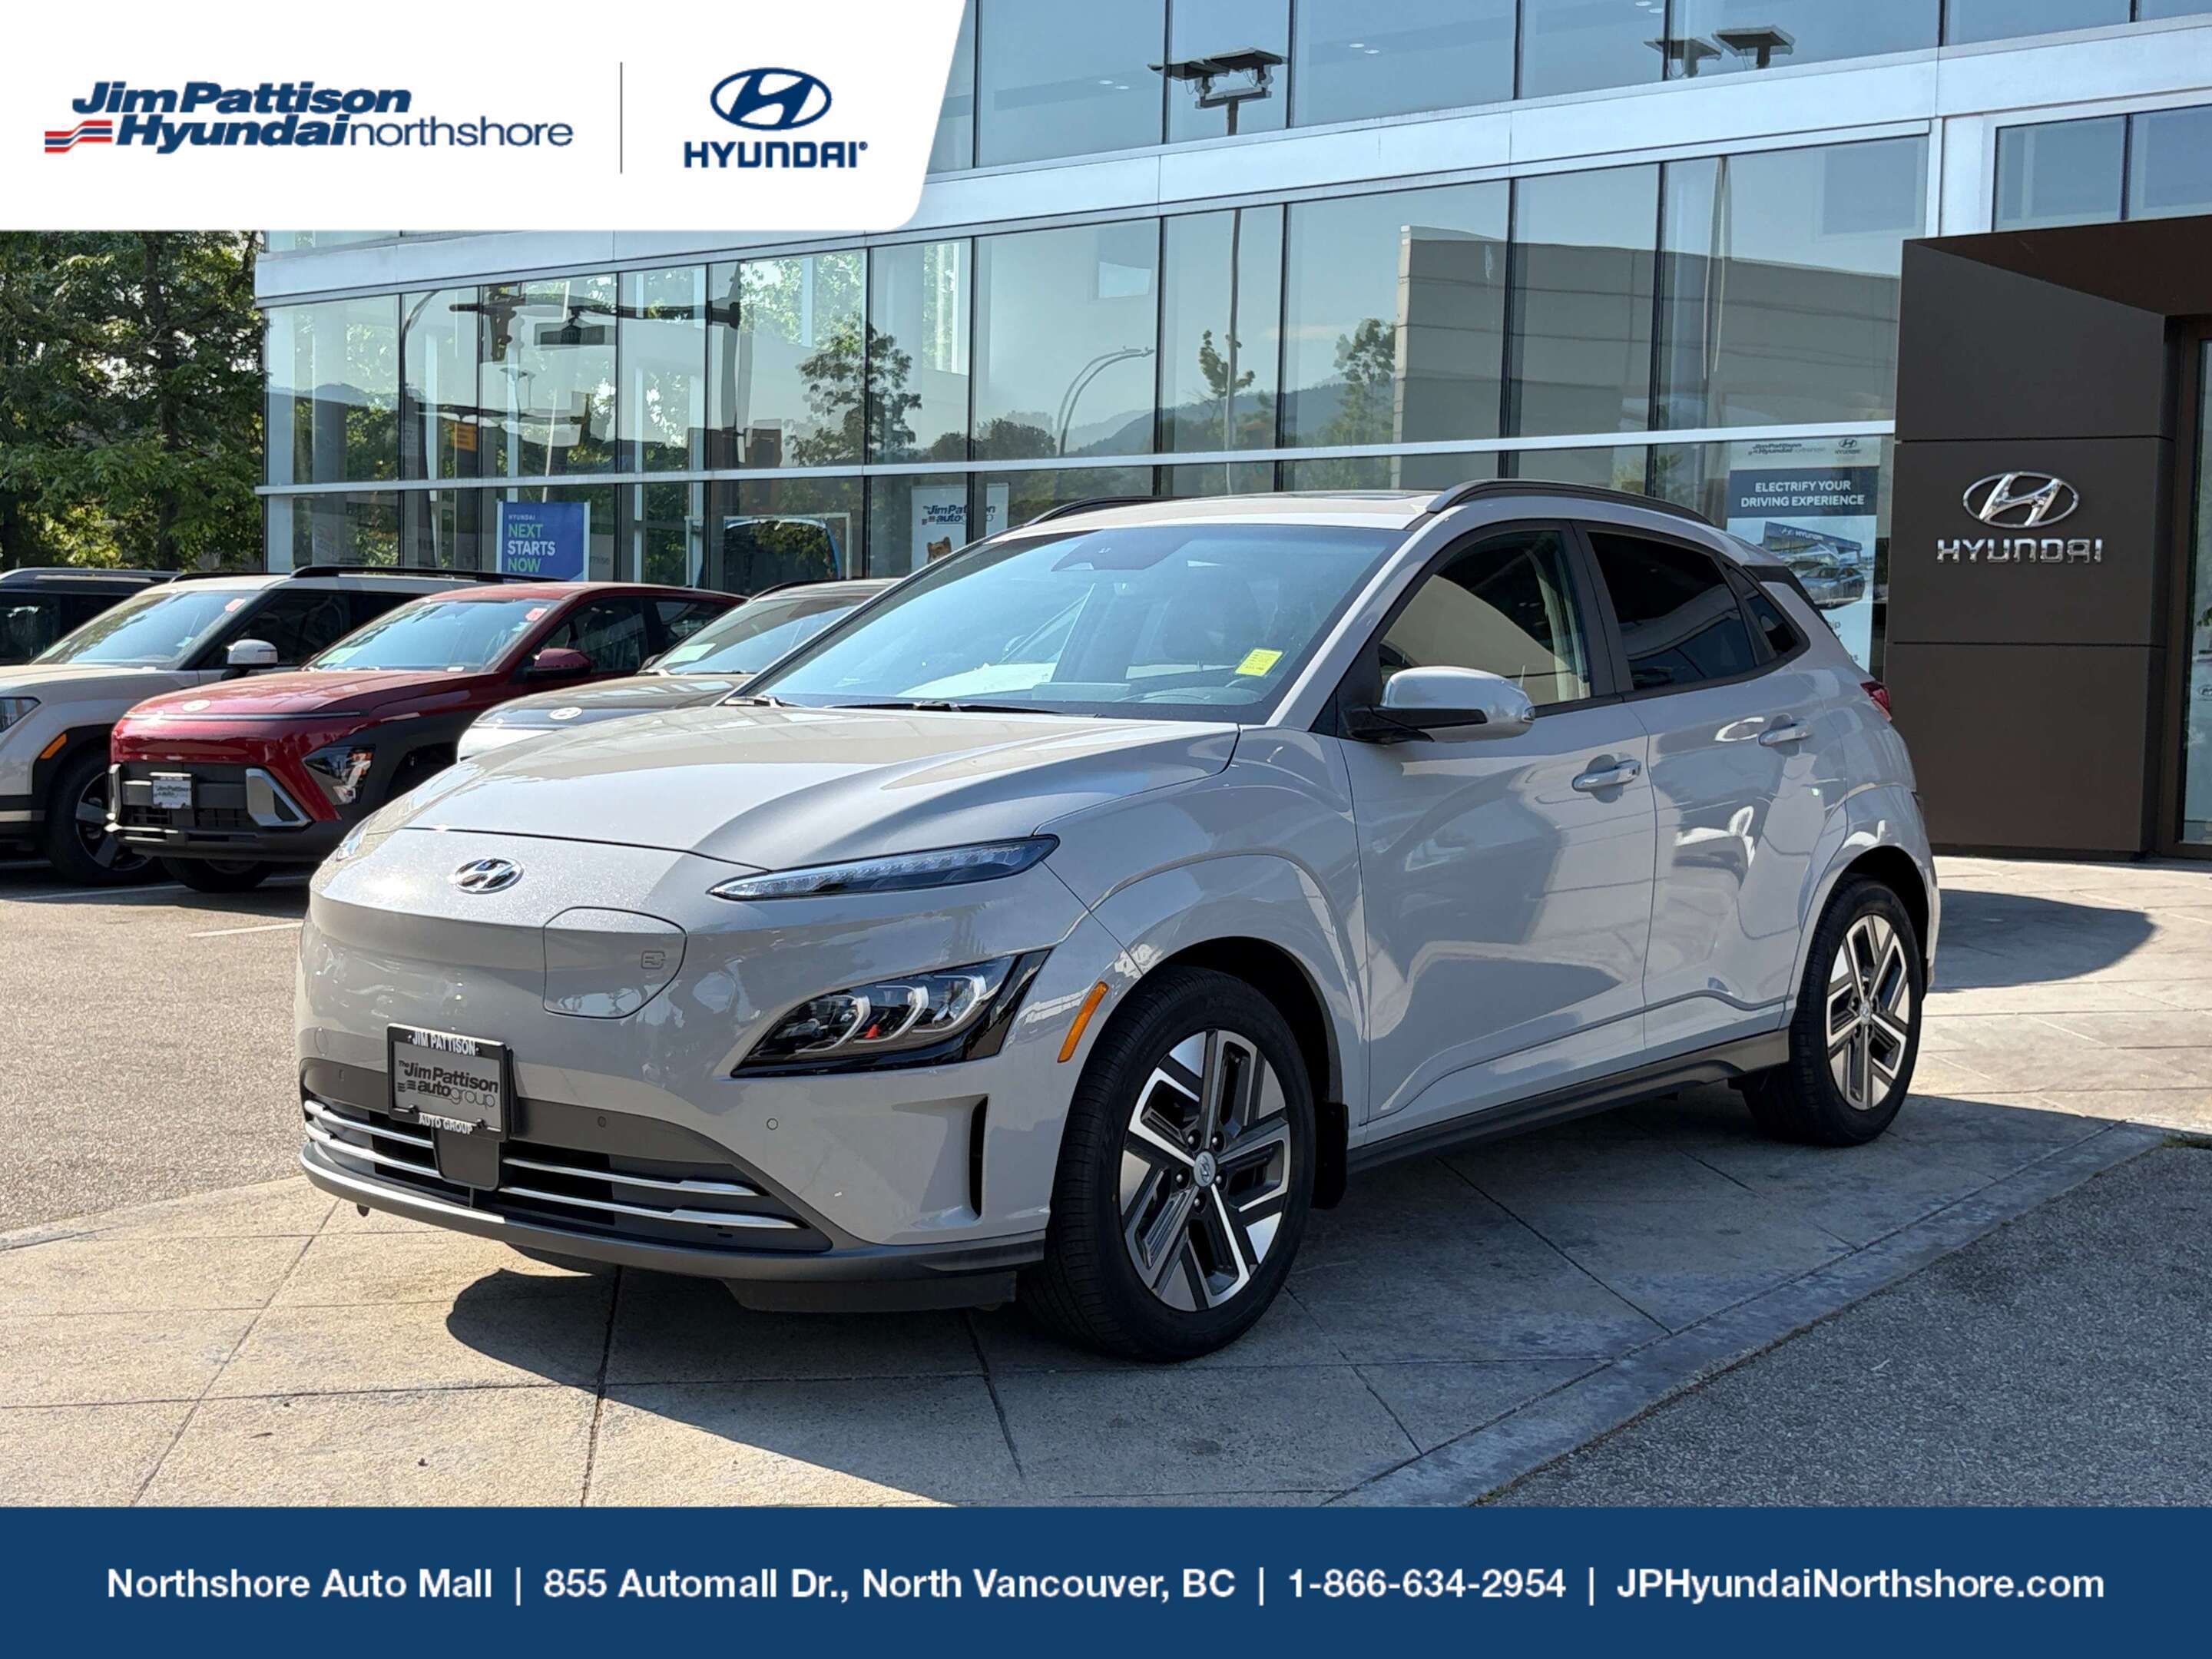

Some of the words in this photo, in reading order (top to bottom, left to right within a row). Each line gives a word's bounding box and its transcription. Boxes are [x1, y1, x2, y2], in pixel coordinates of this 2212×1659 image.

[1754, 481, 1816, 493] ELECTRIFY
[1817, 480, 1852, 492] YOUR
[1740, 496, 1790, 508] DRIVING
[1791, 494, 1865, 507] EXPERIENCE
[508, 523, 544, 538] NEXT
[507, 540, 556, 556] STARTS
[1936, 538, 2104, 564] HYUNDAI
[507, 557, 541, 572] NOW
[412, 1031, 429, 1048] JIM
[430, 1034, 476, 1056] PATTISON
[418, 1114, 442, 1128] AUTO
[442, 1119, 473, 1135] GROUP
